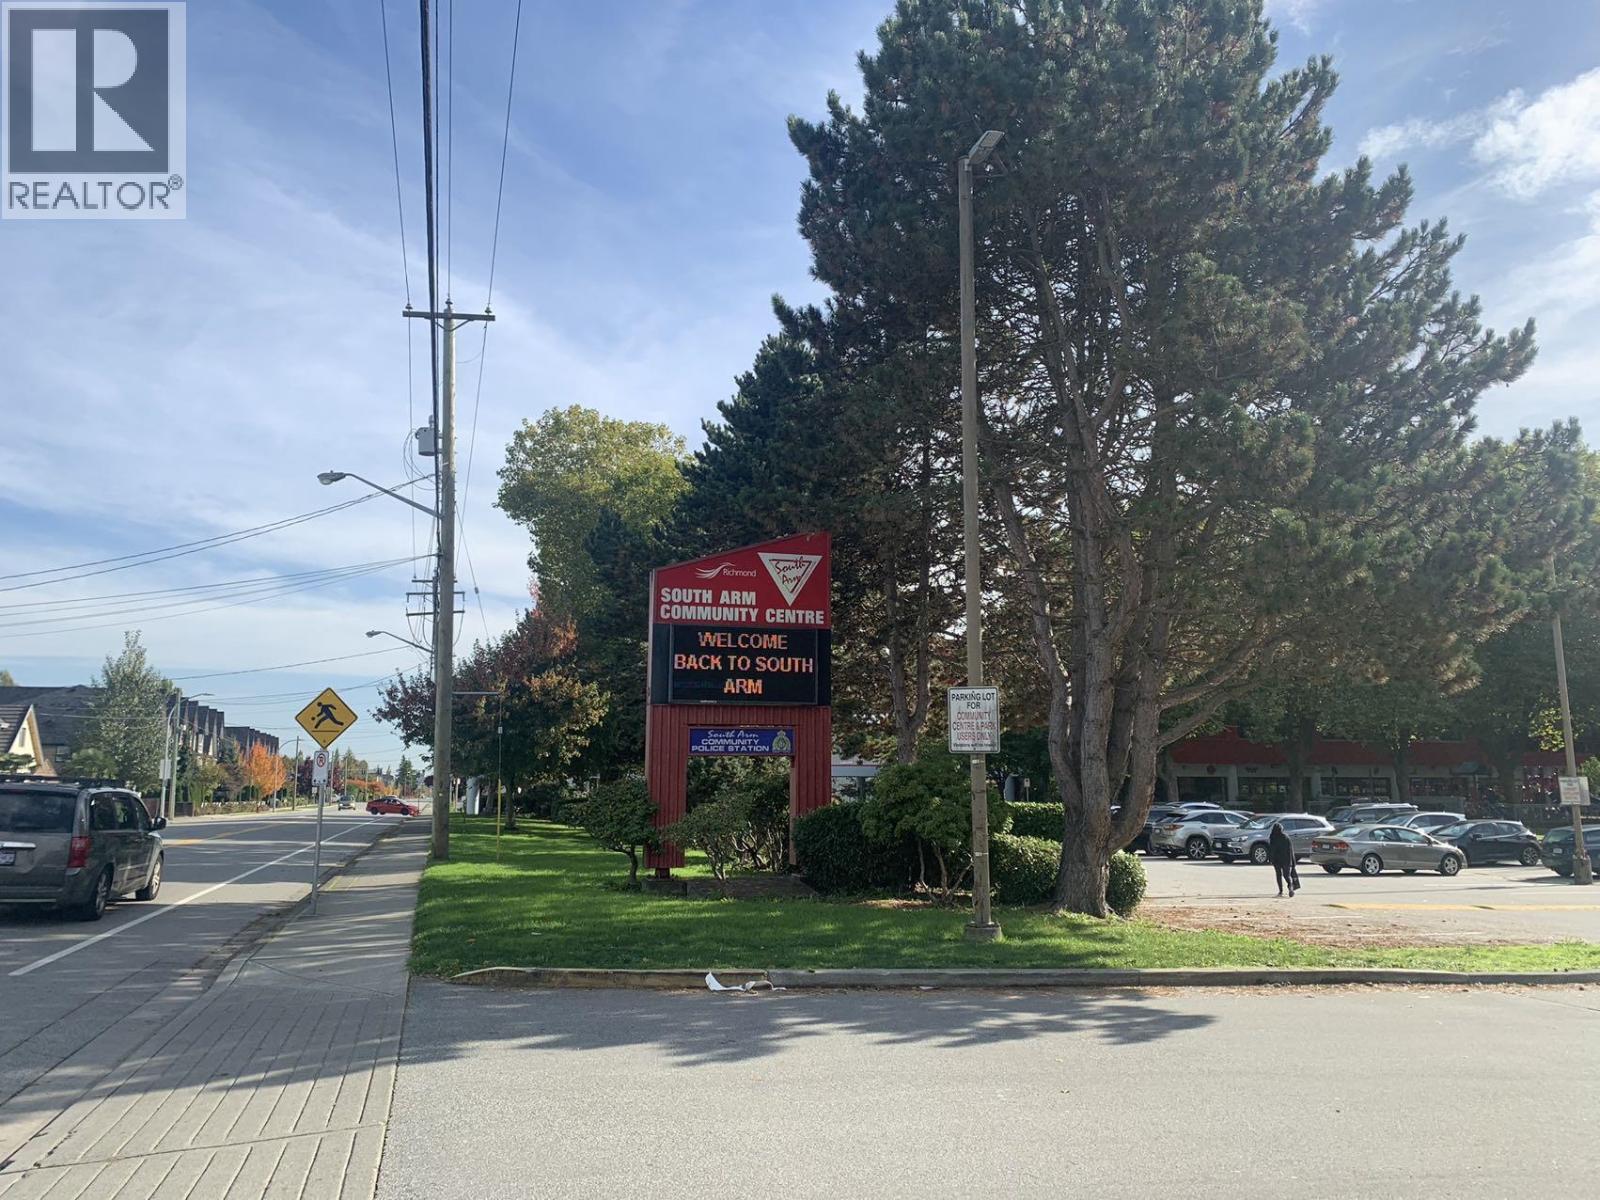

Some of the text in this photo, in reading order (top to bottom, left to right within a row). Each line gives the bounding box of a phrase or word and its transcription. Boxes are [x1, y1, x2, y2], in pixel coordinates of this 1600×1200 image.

[722, 568, 757, 577] Richmond
[775, 556, 806, 575] South
[782, 574, 802, 585] Arm
[660, 587, 756, 606] SOUTH ARM
[660, 605, 825, 625] COMMUNITY CENTRE
[698, 631, 788, 650] WELCOME
[673, 654, 814, 673] BACK TO SOUTH
[723, 678, 763, 695] ARM
[707, 729, 759, 739] South Arm
[952, 722, 975, 730] CENTRE
